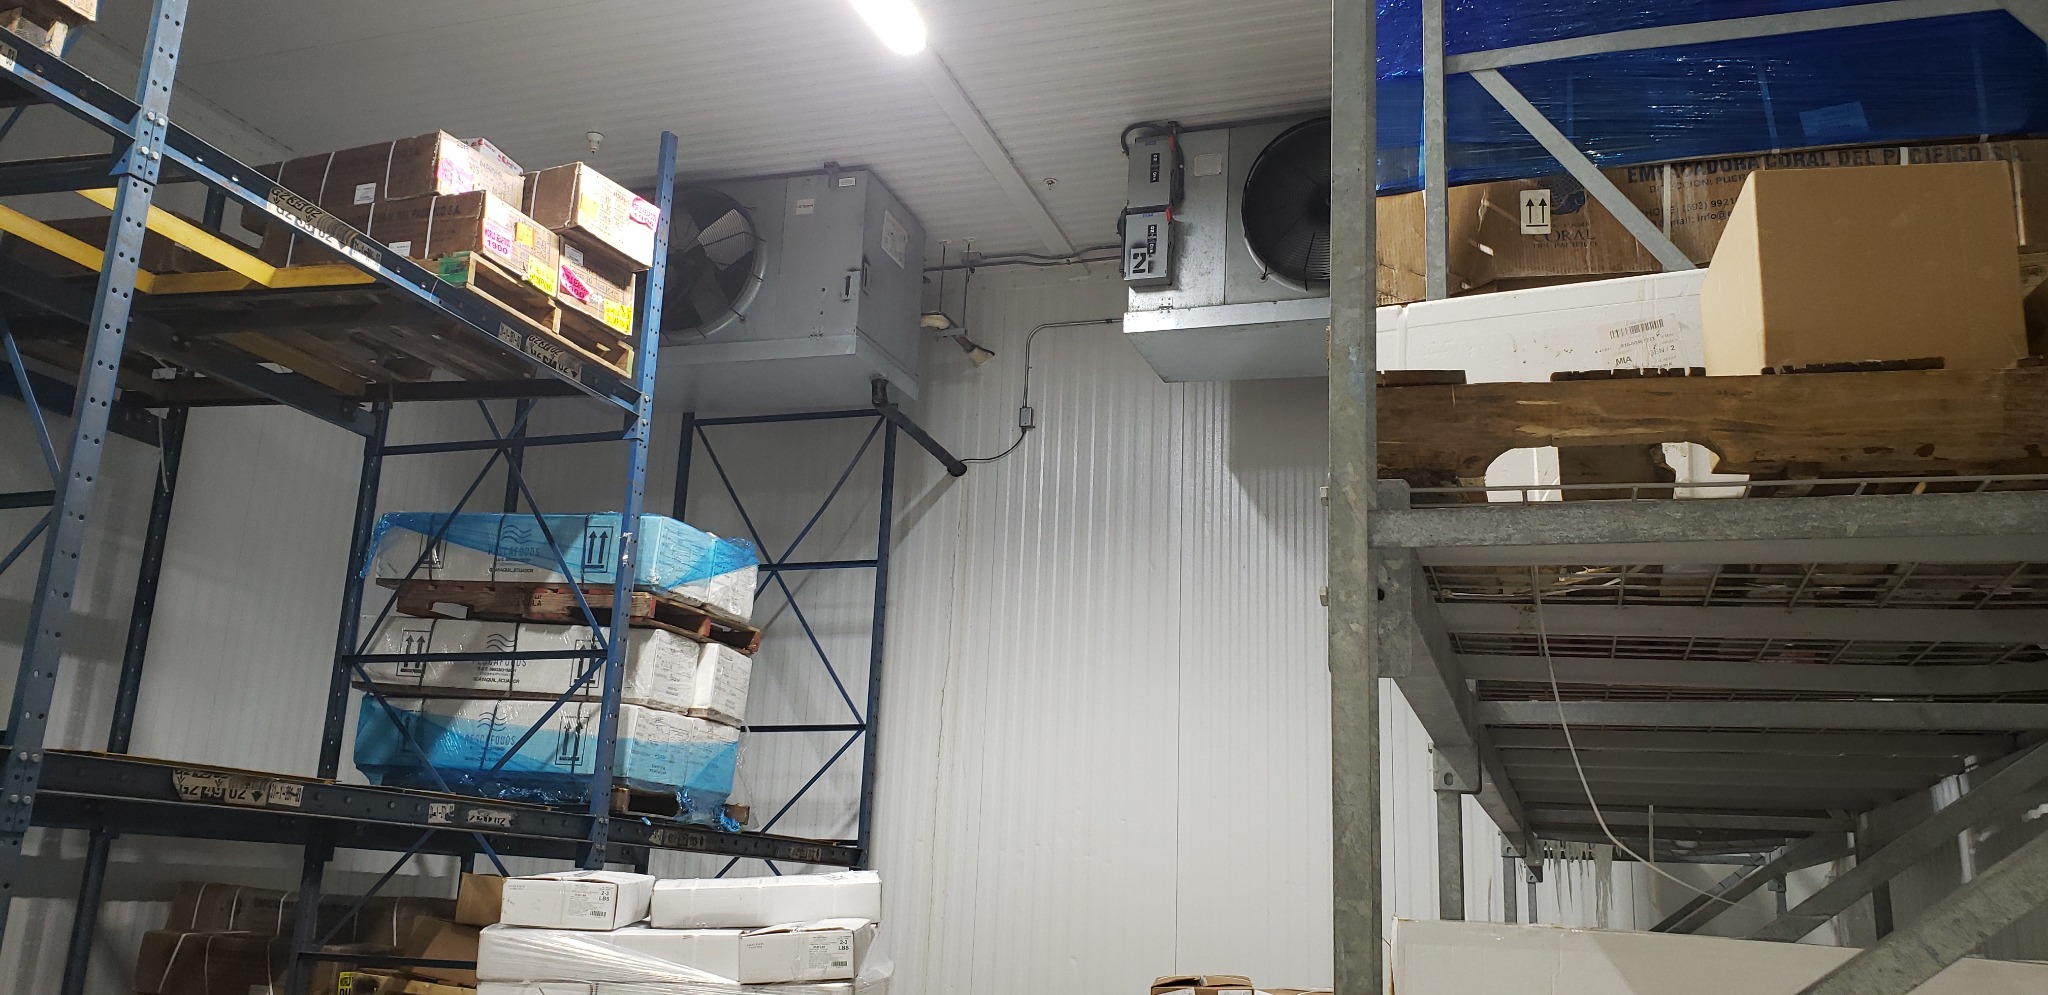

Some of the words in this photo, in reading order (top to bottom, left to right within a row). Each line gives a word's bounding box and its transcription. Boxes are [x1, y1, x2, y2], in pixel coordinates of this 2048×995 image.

[1765, 152, 1831, 168] CORAL
[1838, 149, 1877, 166] DEL
[1884, 146, 1983, 166] PCIFICO
[487, 239, 508, 255] 1900
[1132, 252, 1147, 274] 2
[1615, 355, 1632, 366] MIA
[487, 547, 540, 558] PSCAFOODS
[465, 735, 516, 746] PESCFOODS
